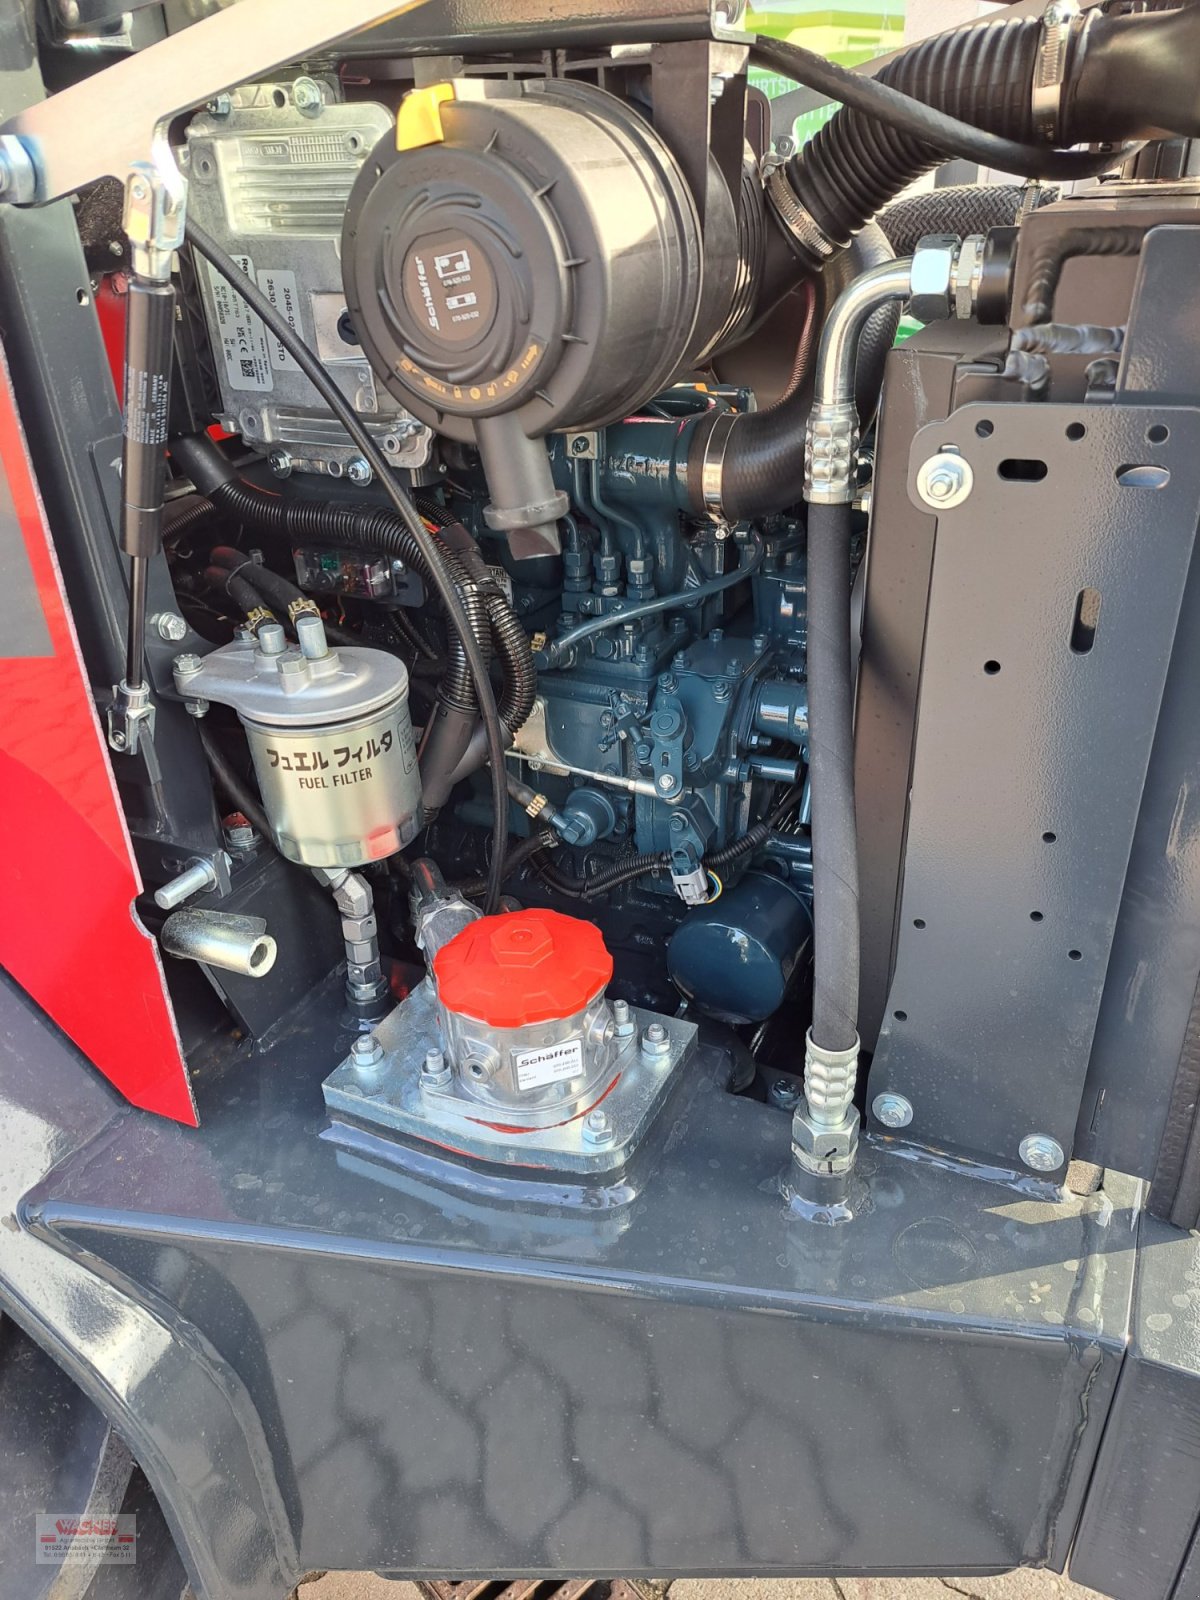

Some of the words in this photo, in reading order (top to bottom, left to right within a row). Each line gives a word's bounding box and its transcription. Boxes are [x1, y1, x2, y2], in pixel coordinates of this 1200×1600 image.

[266, 748, 329, 772] フュエル
[333, 730, 393, 768] フィルタ
[298, 776, 328, 789] FUEL
[333, 767, 373, 787] FILTER
